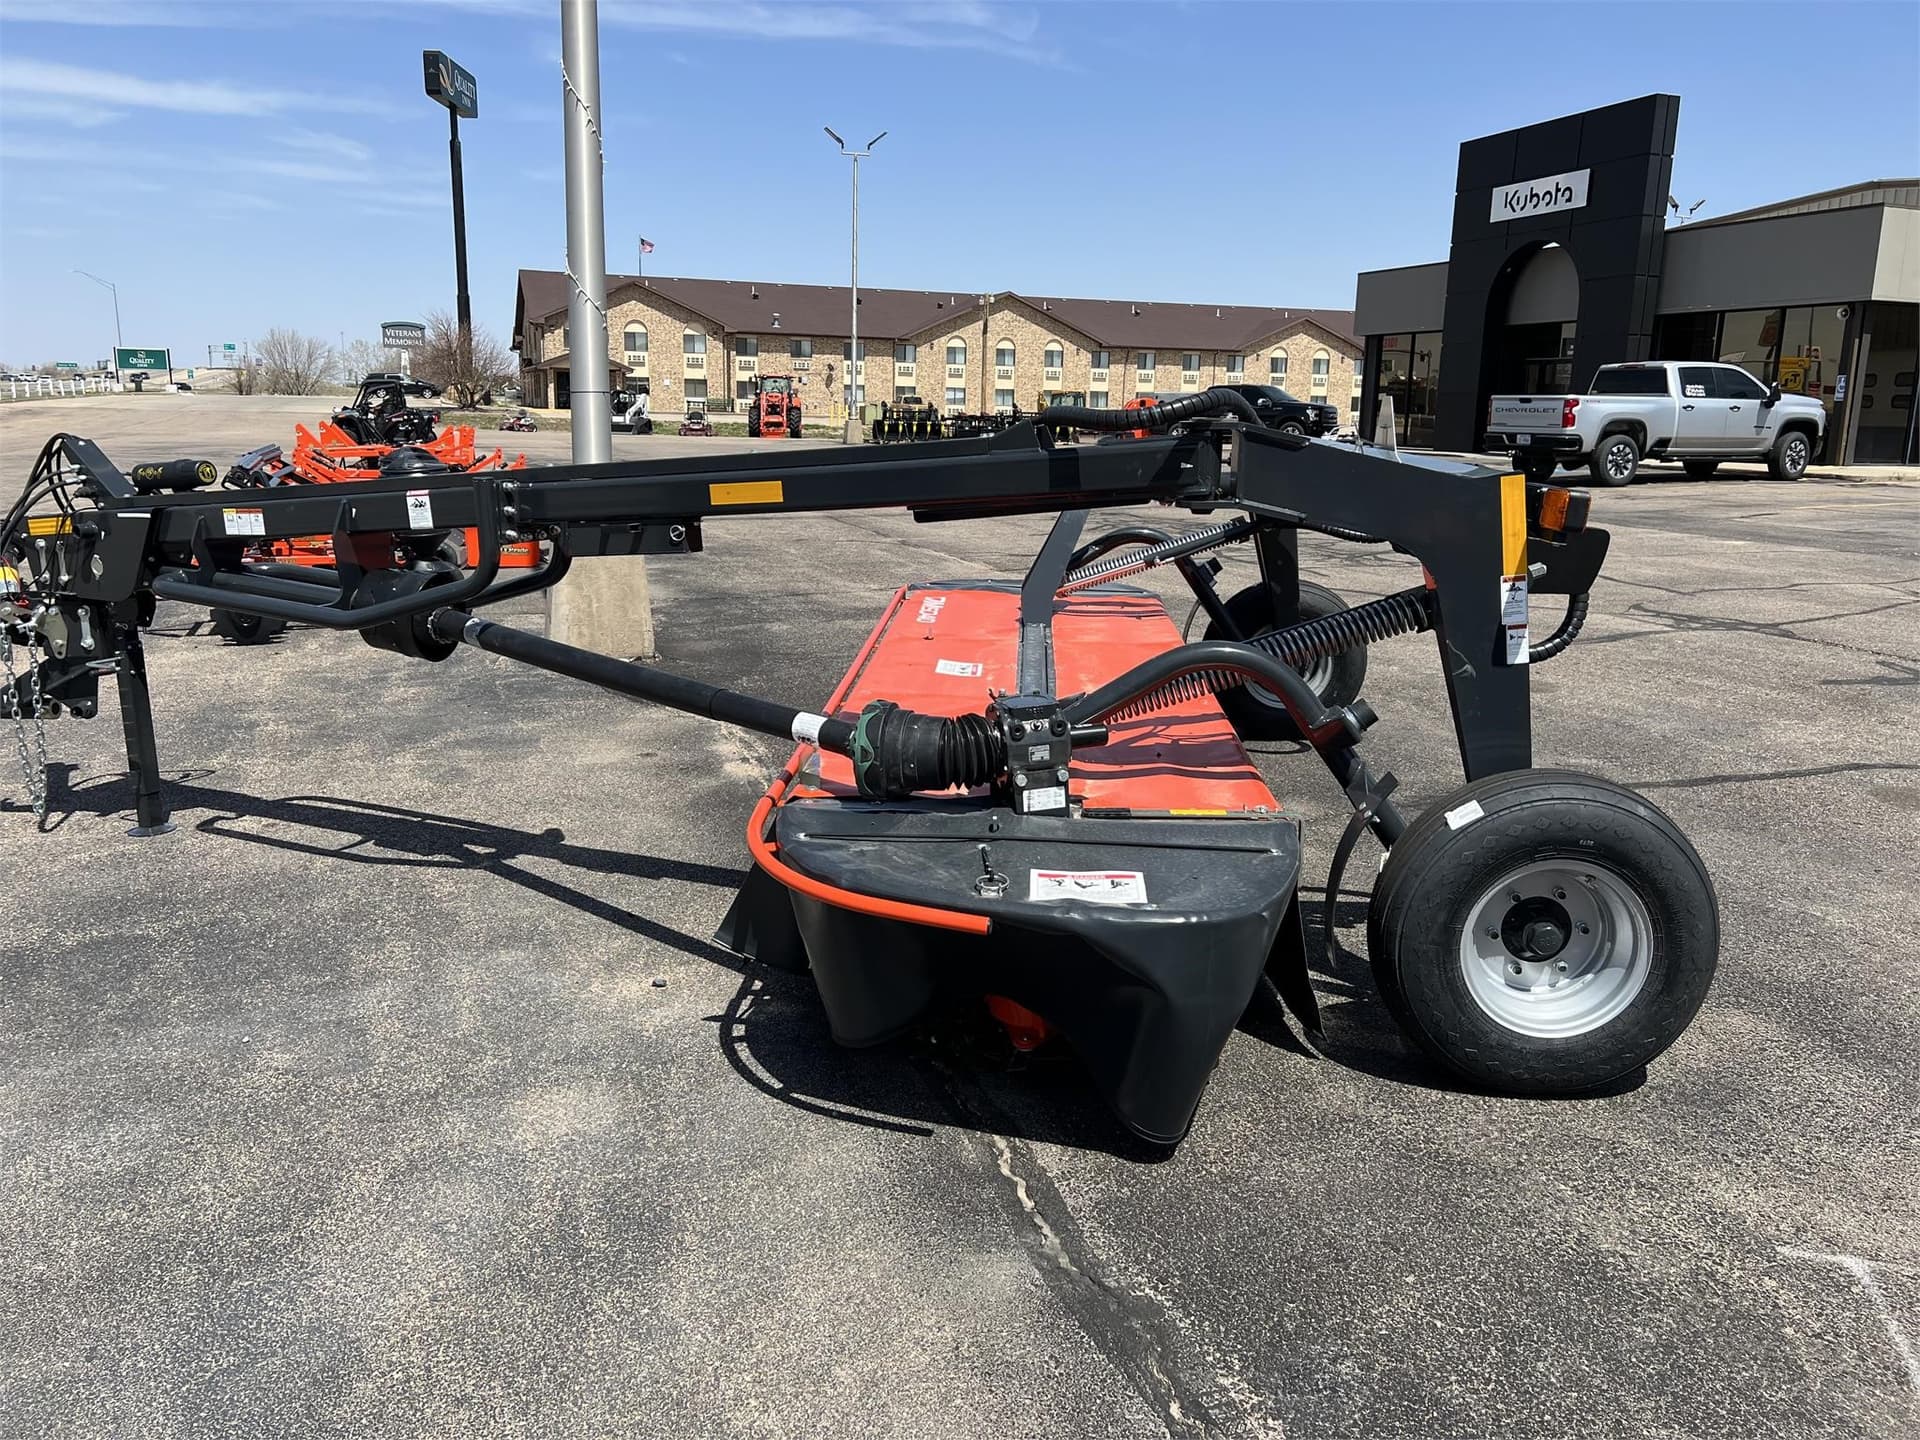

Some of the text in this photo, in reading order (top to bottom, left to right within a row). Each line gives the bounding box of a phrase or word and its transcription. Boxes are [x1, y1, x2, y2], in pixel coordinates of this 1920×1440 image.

[454, 70, 476, 100] QUALITY
[1504, 181, 1574, 213] Kubota
[385, 328, 422, 337] VETERANS
[384, 337, 423, 346] MEMORIAL
[129, 356, 155, 365] QUALITY
